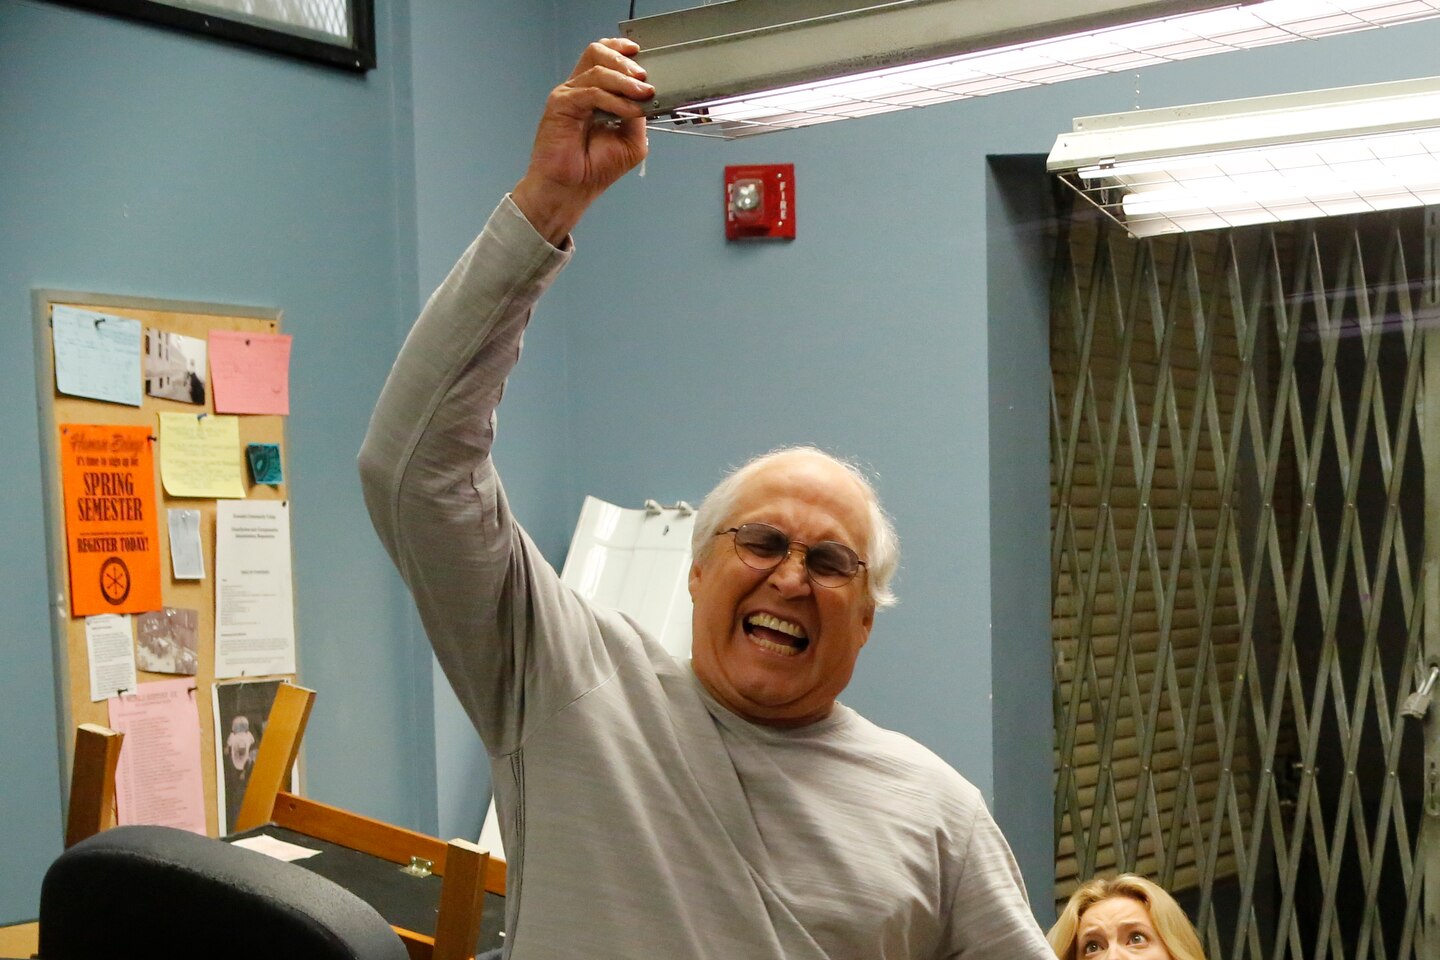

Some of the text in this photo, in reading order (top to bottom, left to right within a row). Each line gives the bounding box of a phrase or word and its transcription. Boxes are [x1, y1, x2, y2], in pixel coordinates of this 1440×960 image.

[83, 472, 134, 496] SPRING
[77, 497, 143, 521] SEMESTER
[77, 536, 150, 553] REGISTER TODAY!
